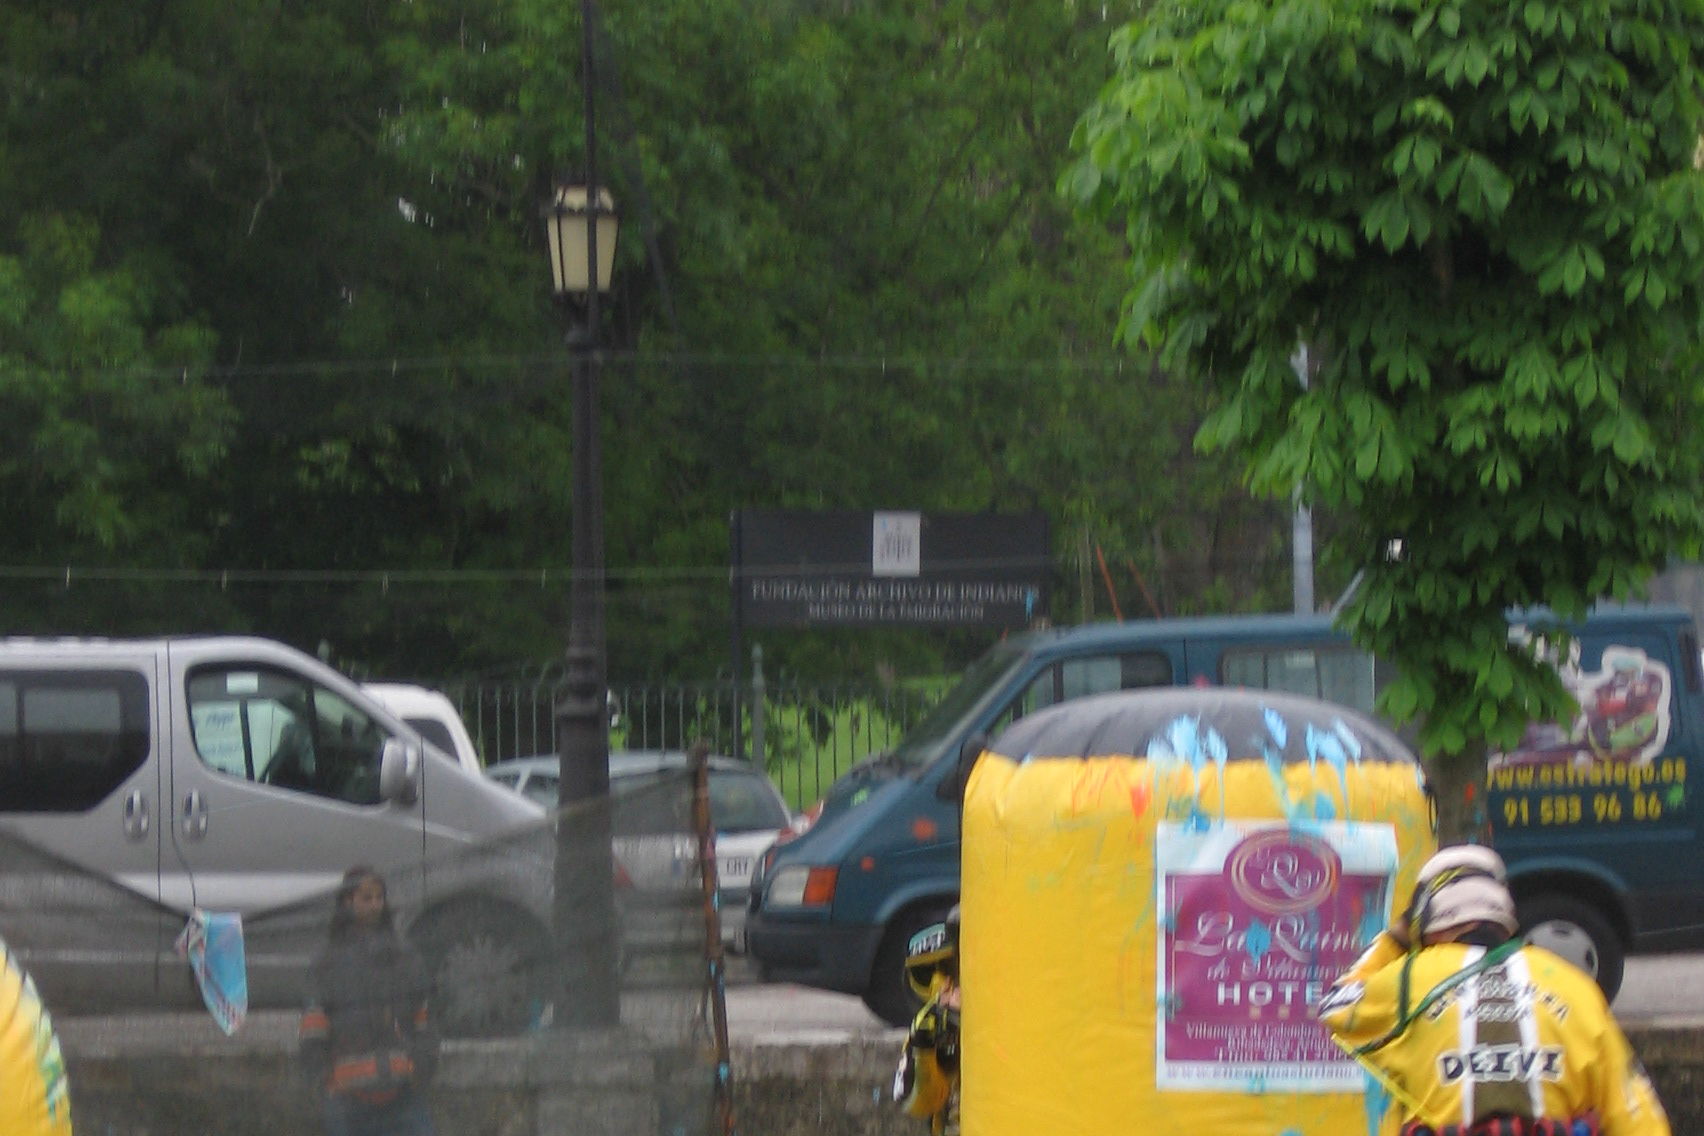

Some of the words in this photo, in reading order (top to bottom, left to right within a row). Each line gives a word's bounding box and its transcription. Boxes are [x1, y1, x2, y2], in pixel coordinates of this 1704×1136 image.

[856, 579, 931, 602] ARCHIVO
[936, 581, 955, 601] DE
[808, 602, 855, 619] MUSEO
[859, 603, 875, 619] DE
[880, 603, 896, 619] LA
[1503, 795, 1529, 827] 91
[1593, 790, 1622, 822] 96
[1216, 981, 1324, 1007] HOTE
